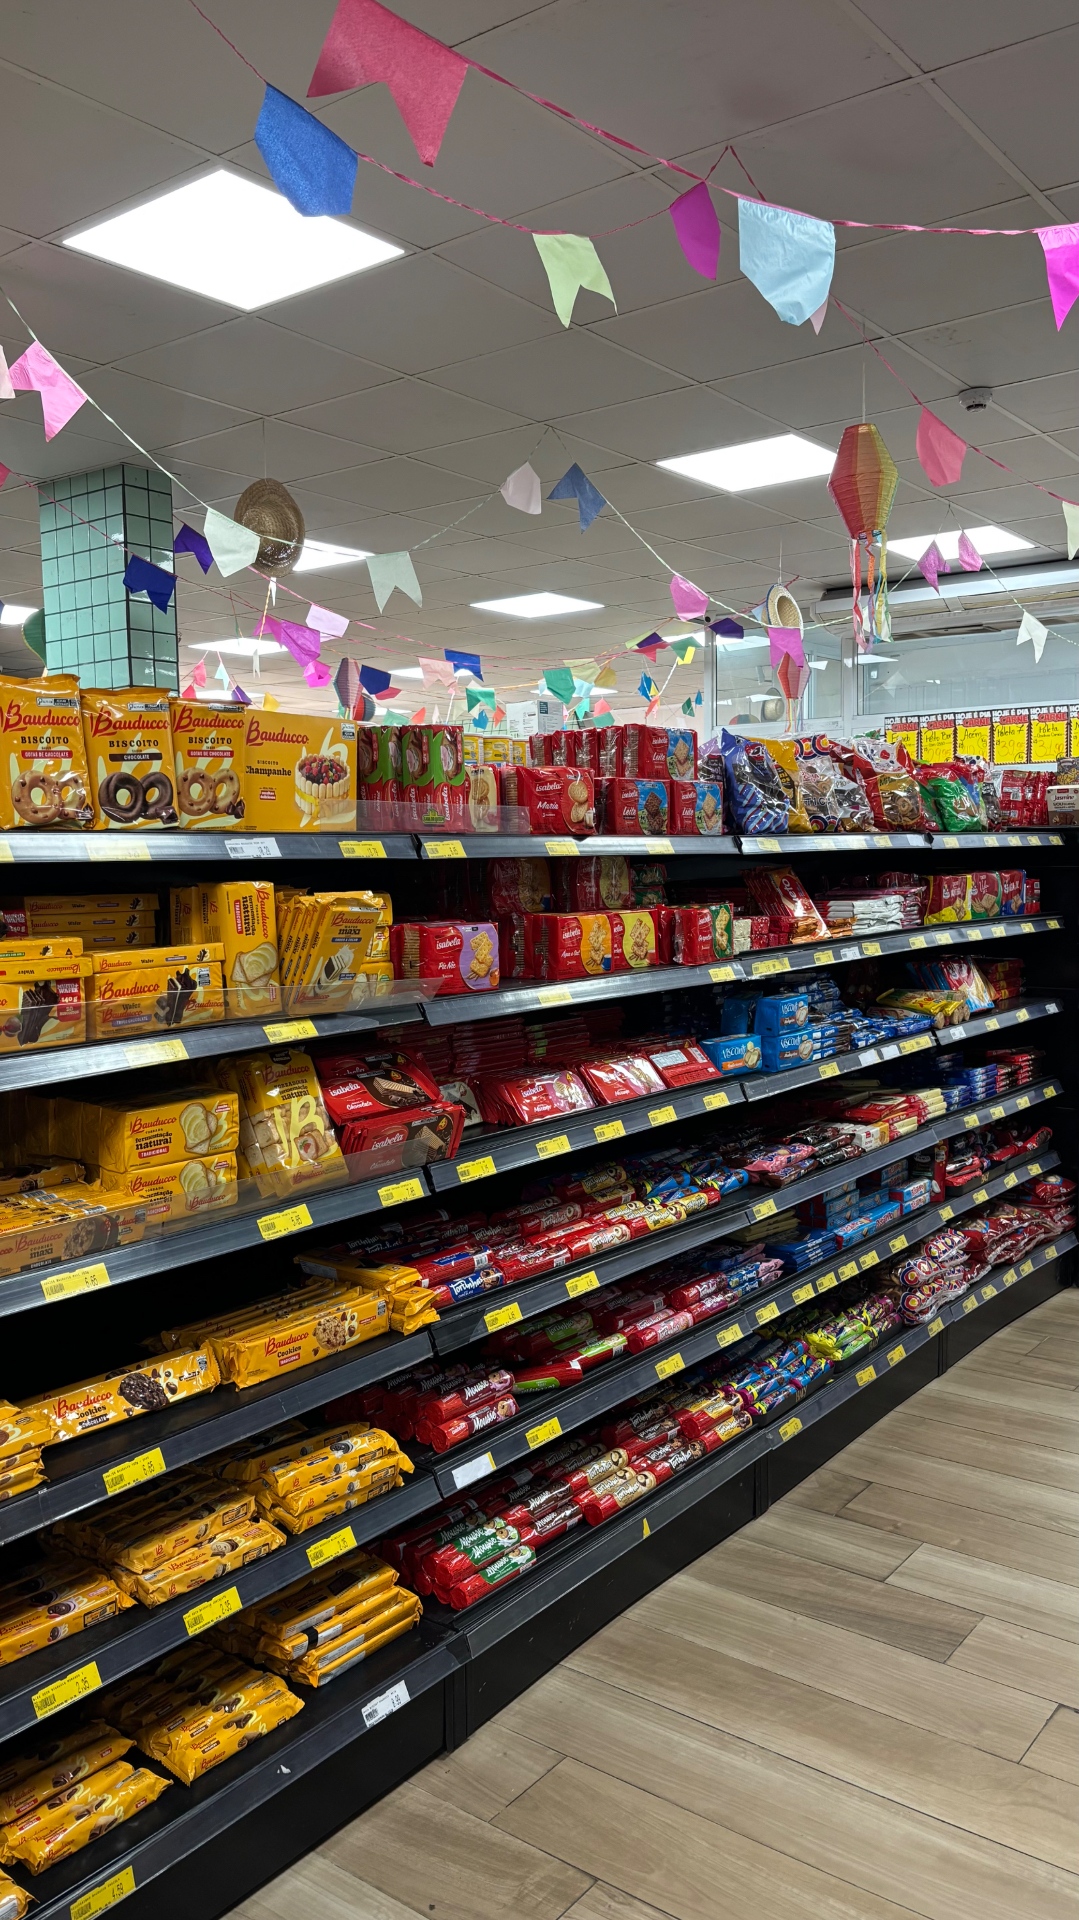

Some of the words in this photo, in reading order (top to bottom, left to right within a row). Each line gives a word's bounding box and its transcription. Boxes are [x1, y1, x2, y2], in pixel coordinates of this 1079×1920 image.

[0, 700, 80, 733] Bauducco
[172, 704, 244, 733] Bauducco
[956, 712, 971, 720] HOJE
[980, 710, 991, 718] DIA
[993, 709, 1009, 717] HOJE
[1038, 712, 1067, 722] CARNE
[90, 706, 170, 737] Bauducco
[927, 720, 955, 730] CARNE
[963, 717, 991, 727] CARNE
[1000, 715, 1028, 725] CARNE
[246, 716, 309, 746] Bauducco
[892, 723, 918, 732] CARNE
[21, 736, 69, 744] BISCOITO
[652, 752, 666, 762] Leite
[536, 783, 561, 792] isabela
[536, 800, 559, 810] Maria
[622, 806, 637, 816] Leite
[682, 806, 694, 816] Leite
[234, 902, 242, 933] TRADICIONAL
[242, 896, 250, 936] natural
[256, 888, 269, 939] Bauducco
[331, 912, 374, 927] Bauducco
[563, 928, 581, 939] isabela
[436, 937, 461, 950] isabela
[100, 958, 132, 970] Bauducco
[100, 978, 160, 1004] Bauducco
[260, 1064, 310, 1086] Bauducco
[281, 1090, 310, 1100] natural
[329, 1082, 360, 1097] isabela
[521, 1085, 543, 1097] isabela
[346, 1100, 372, 1110] Chocolate
[130, 1115, 177, 1135] Bauducco
[135, 1132, 173, 1144] fermentação
[136, 1137, 172, 1150] natural
[372, 1134, 403, 1151] isabela
[141, 1148, 168, 1157] TRADICIONAL
[131, 1174, 177, 1193] Bauducco
[16, 1232, 63, 1254] Bauducco
[30, 1248, 53, 1259] maxi
[450, 1274, 483, 1295] Tortinhas
[264, 1332, 309, 1357] Bauducco
[277, 1346, 302, 1358] Cookies
[279, 1355, 299, 1365] TRADICIONAL
[464, 1379, 489, 1400] Mousse
[53, 1391, 112, 1419] Bauducco
[473, 1409, 496, 1433] Mousse
[486, 1556, 509, 1577] Mousse
[201, 1751, 226, 1770] Bauducco
